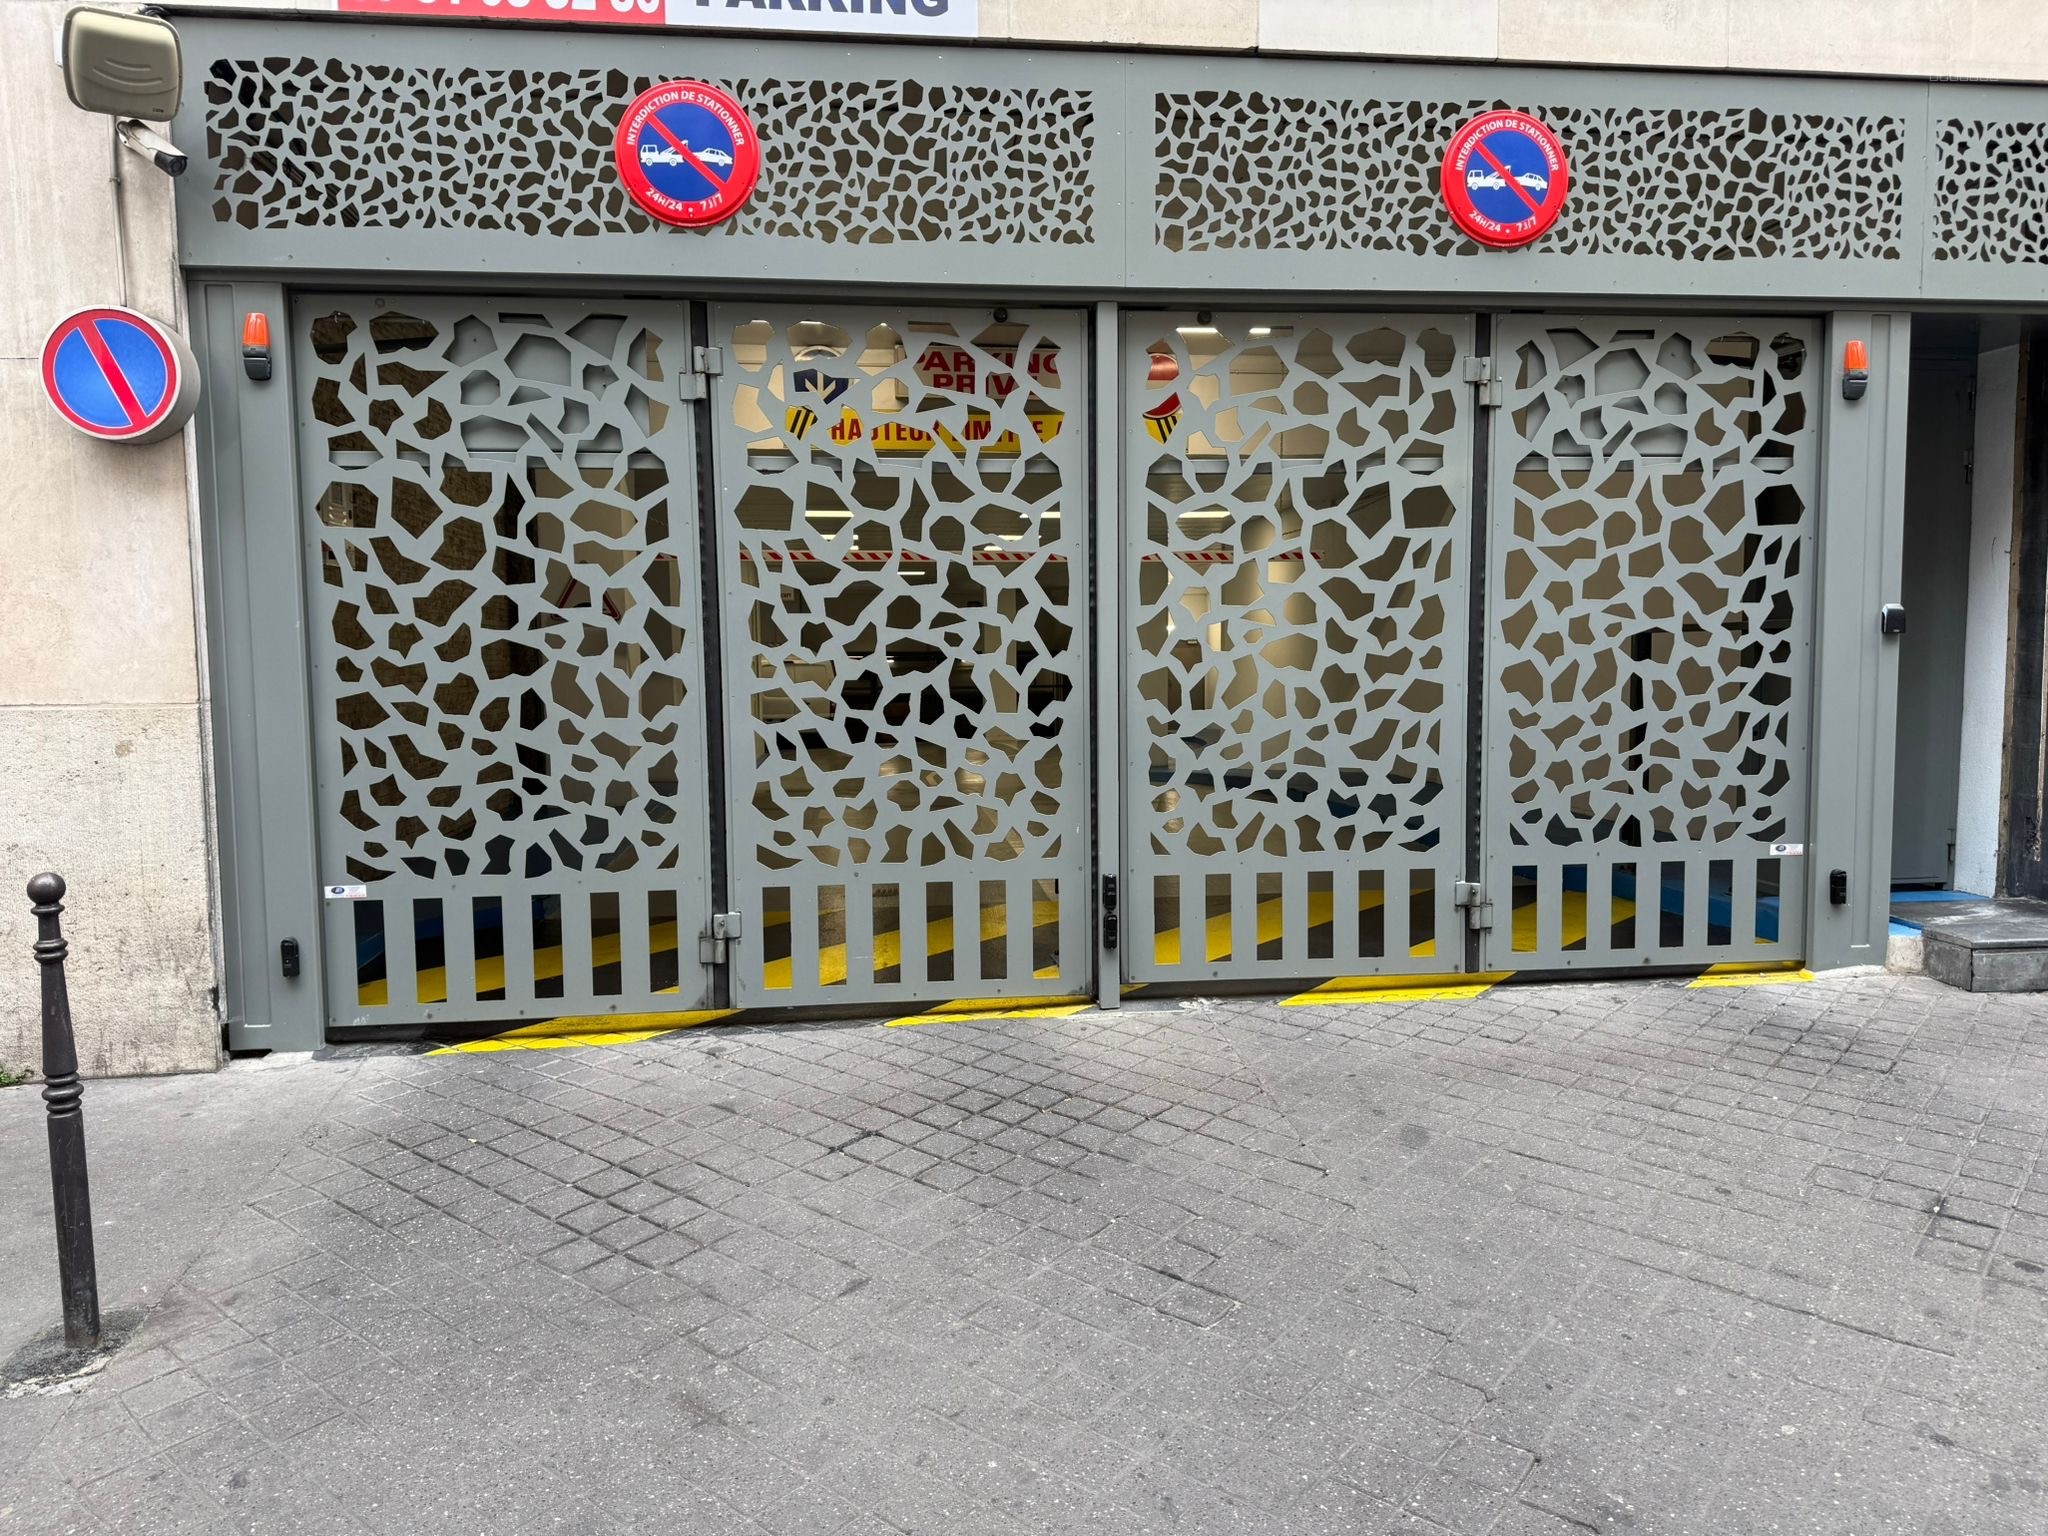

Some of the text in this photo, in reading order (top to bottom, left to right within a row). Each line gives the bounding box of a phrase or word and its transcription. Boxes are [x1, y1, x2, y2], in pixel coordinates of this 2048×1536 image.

[626, 91, 745, 146] INTERDICTION DE STATIONNER
[1455, 119, 1559, 171] INTERDICTION DE STATIONNER
[645, 187, 723, 212] 24H/24 7J/7
[1468, 209, 1537, 233] 24H/24 7J/7
